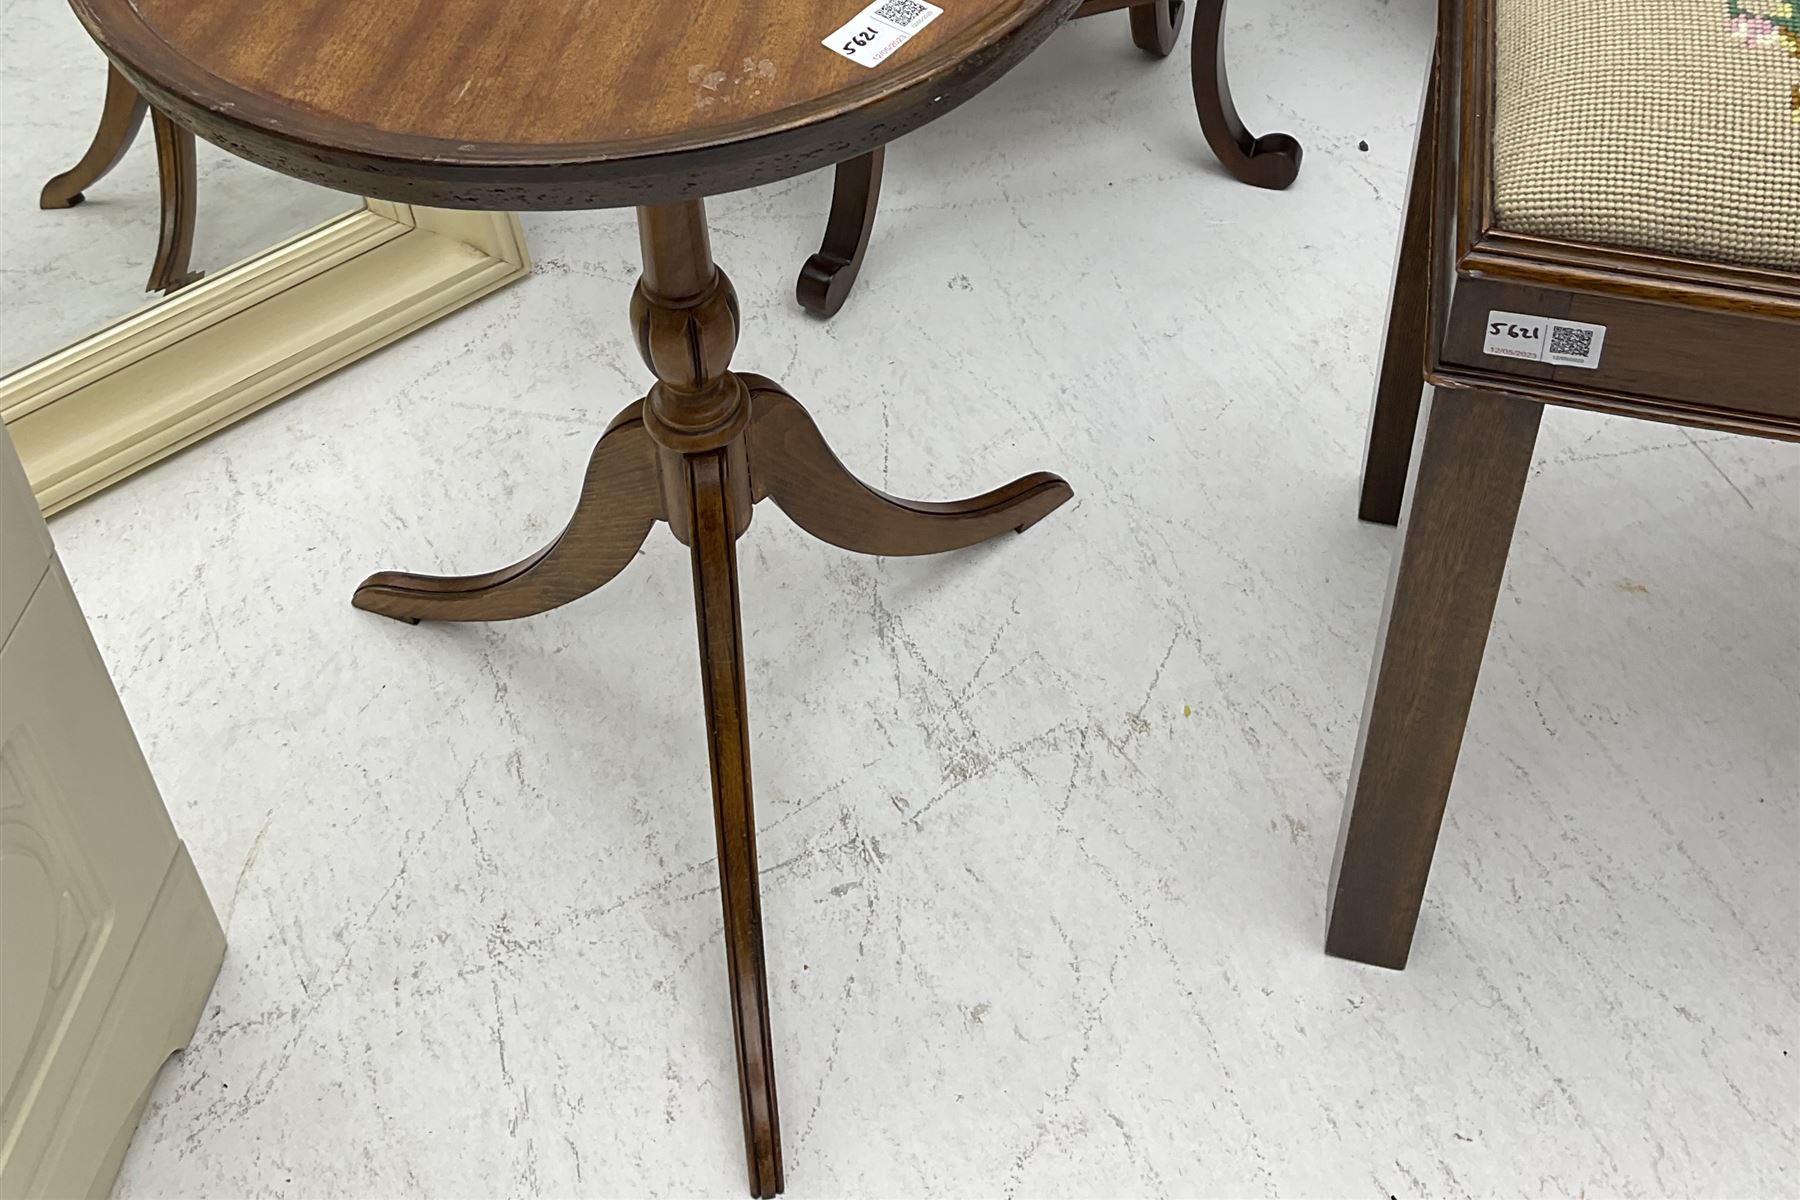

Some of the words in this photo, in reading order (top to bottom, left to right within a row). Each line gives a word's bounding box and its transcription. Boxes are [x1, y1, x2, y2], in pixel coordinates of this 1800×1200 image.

[843, 27, 878, 55] 5621
[1490, 323, 1539, 339] 5621
[1490, 346, 1537, 359] 12/05/2023
